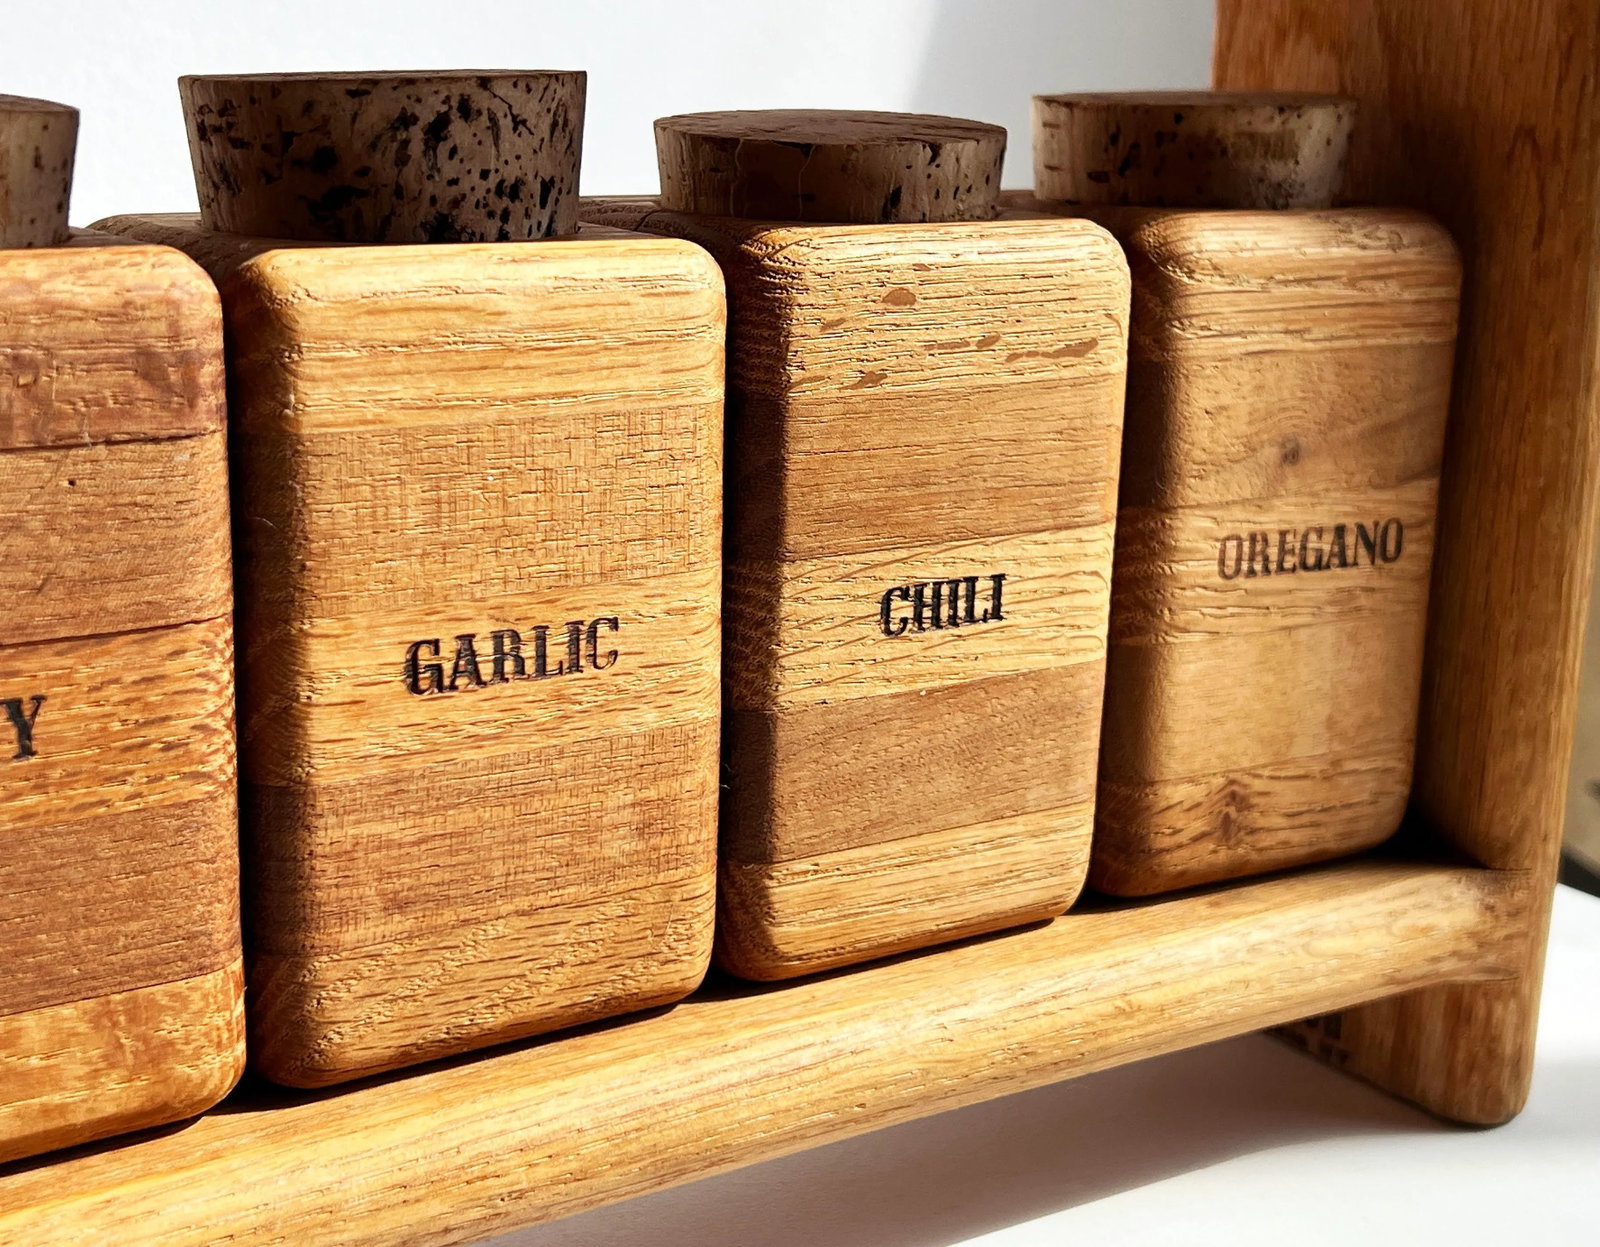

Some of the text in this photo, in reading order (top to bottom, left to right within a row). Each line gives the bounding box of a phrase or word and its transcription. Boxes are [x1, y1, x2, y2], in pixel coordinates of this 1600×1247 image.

[1217, 517, 1404, 580] OREGANO
[880, 573, 1007, 637] CHILI
[404, 616, 619, 695] GARLIC
